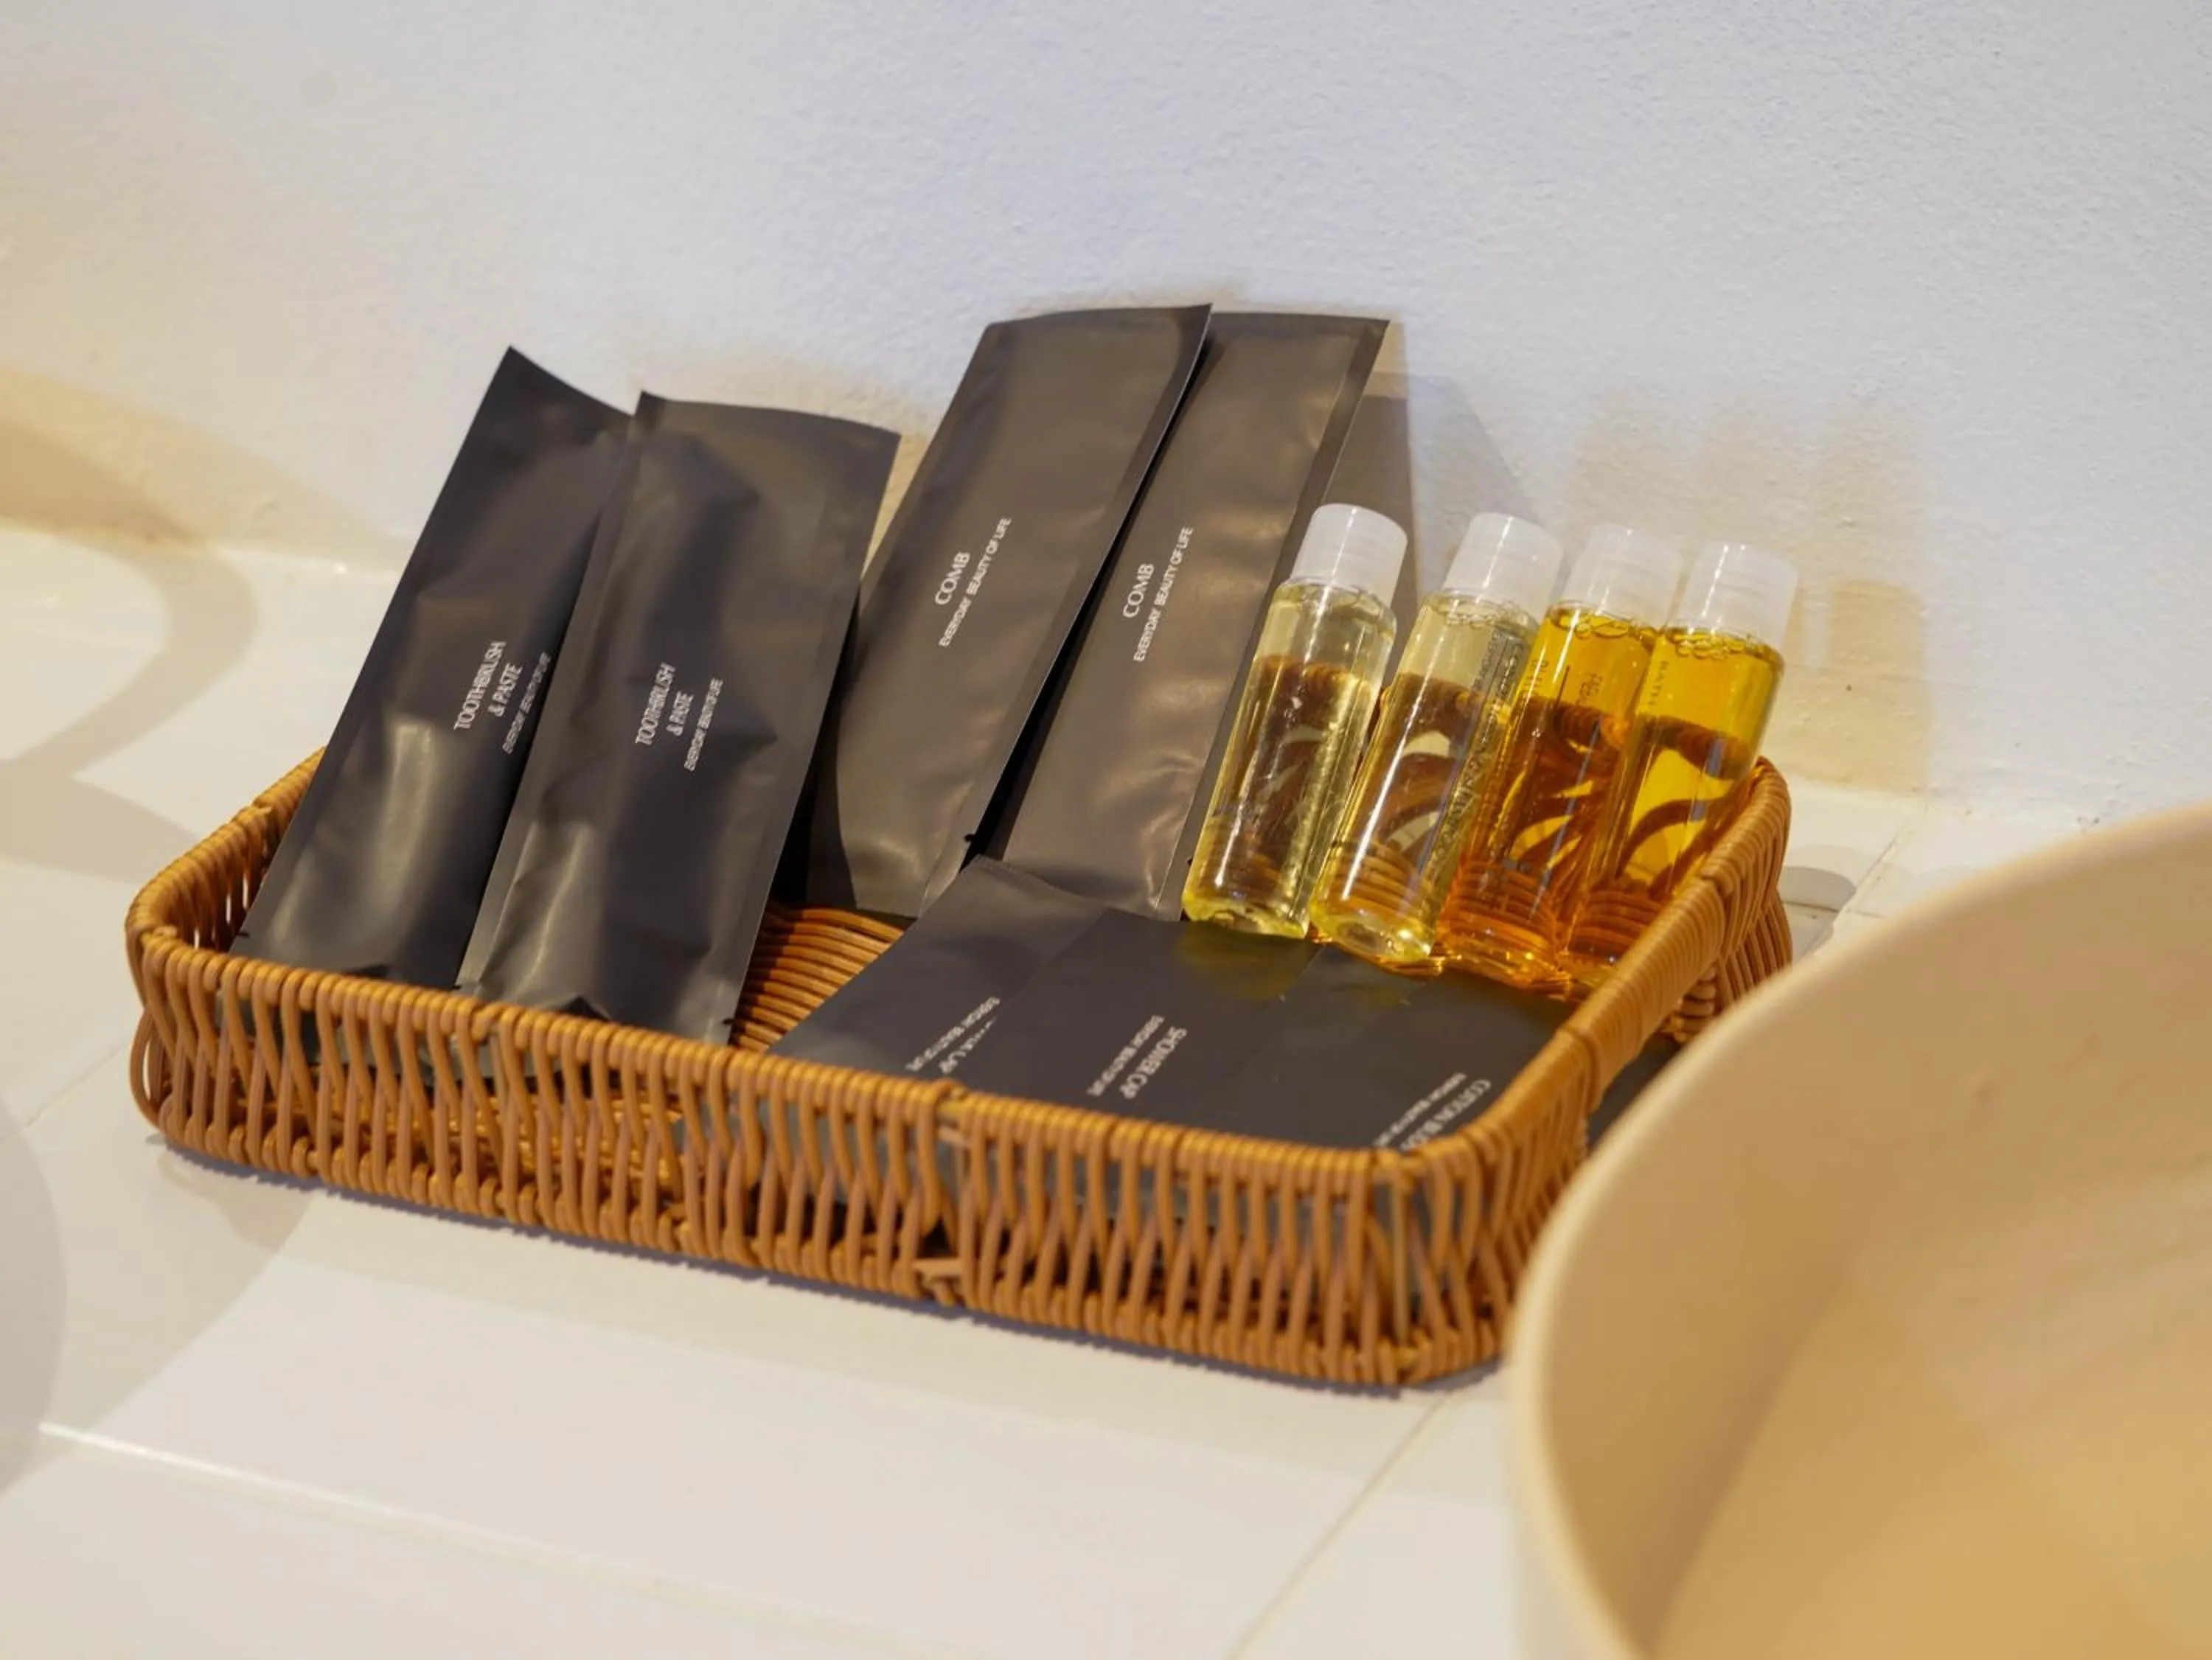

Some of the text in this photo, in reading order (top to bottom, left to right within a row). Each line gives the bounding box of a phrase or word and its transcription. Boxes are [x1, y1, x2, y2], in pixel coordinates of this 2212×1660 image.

[935, 552, 970, 604] COMB
[967, 554, 992, 595] BEAUTY
[986, 539, 999, 554] OF
[993, 517, 1012, 540] LIFE
[1154, 565, 1179, 606] BEAUTY
[1169, 547, 1183, 565] OF
[1177, 526, 1194, 549] LIFE
[1123, 563, 1154, 618] COMB
[453, 641, 507, 730] TOOTHBRUSH
[487, 663, 523, 717] & PASTE
